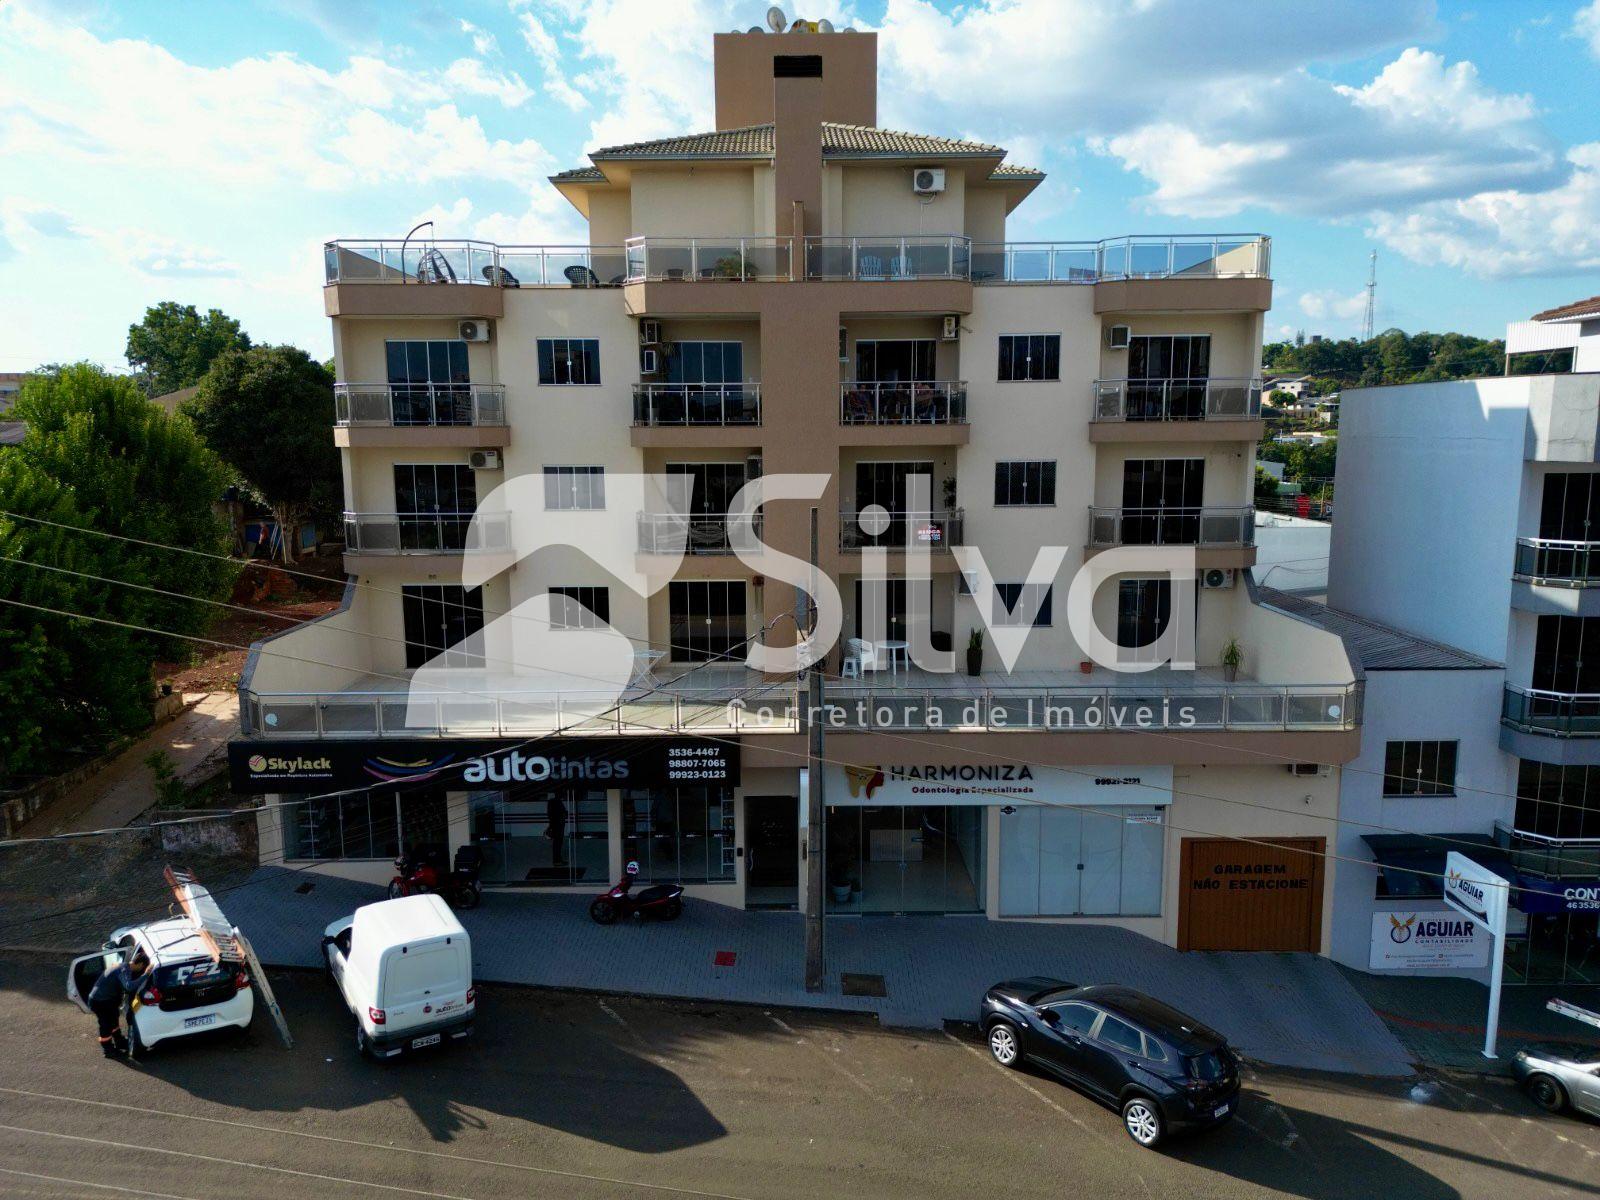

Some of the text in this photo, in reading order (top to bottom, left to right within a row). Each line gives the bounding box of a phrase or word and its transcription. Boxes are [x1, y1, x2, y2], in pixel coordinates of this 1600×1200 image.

[668, 747, 720, 757] 3536-4467
[268, 756, 332, 773] Skylack
[891, 765, 1033, 781] HARMONIZA
[912, 786, 969, 795] Odontologia
[1214, 864, 1286, 875] GARAGEM
[1193, 877, 1309, 890] NÃO ESTACIONE
[1459, 880, 1484, 903] AGUIAR
[1415, 921, 1474, 937] AGUIAR
